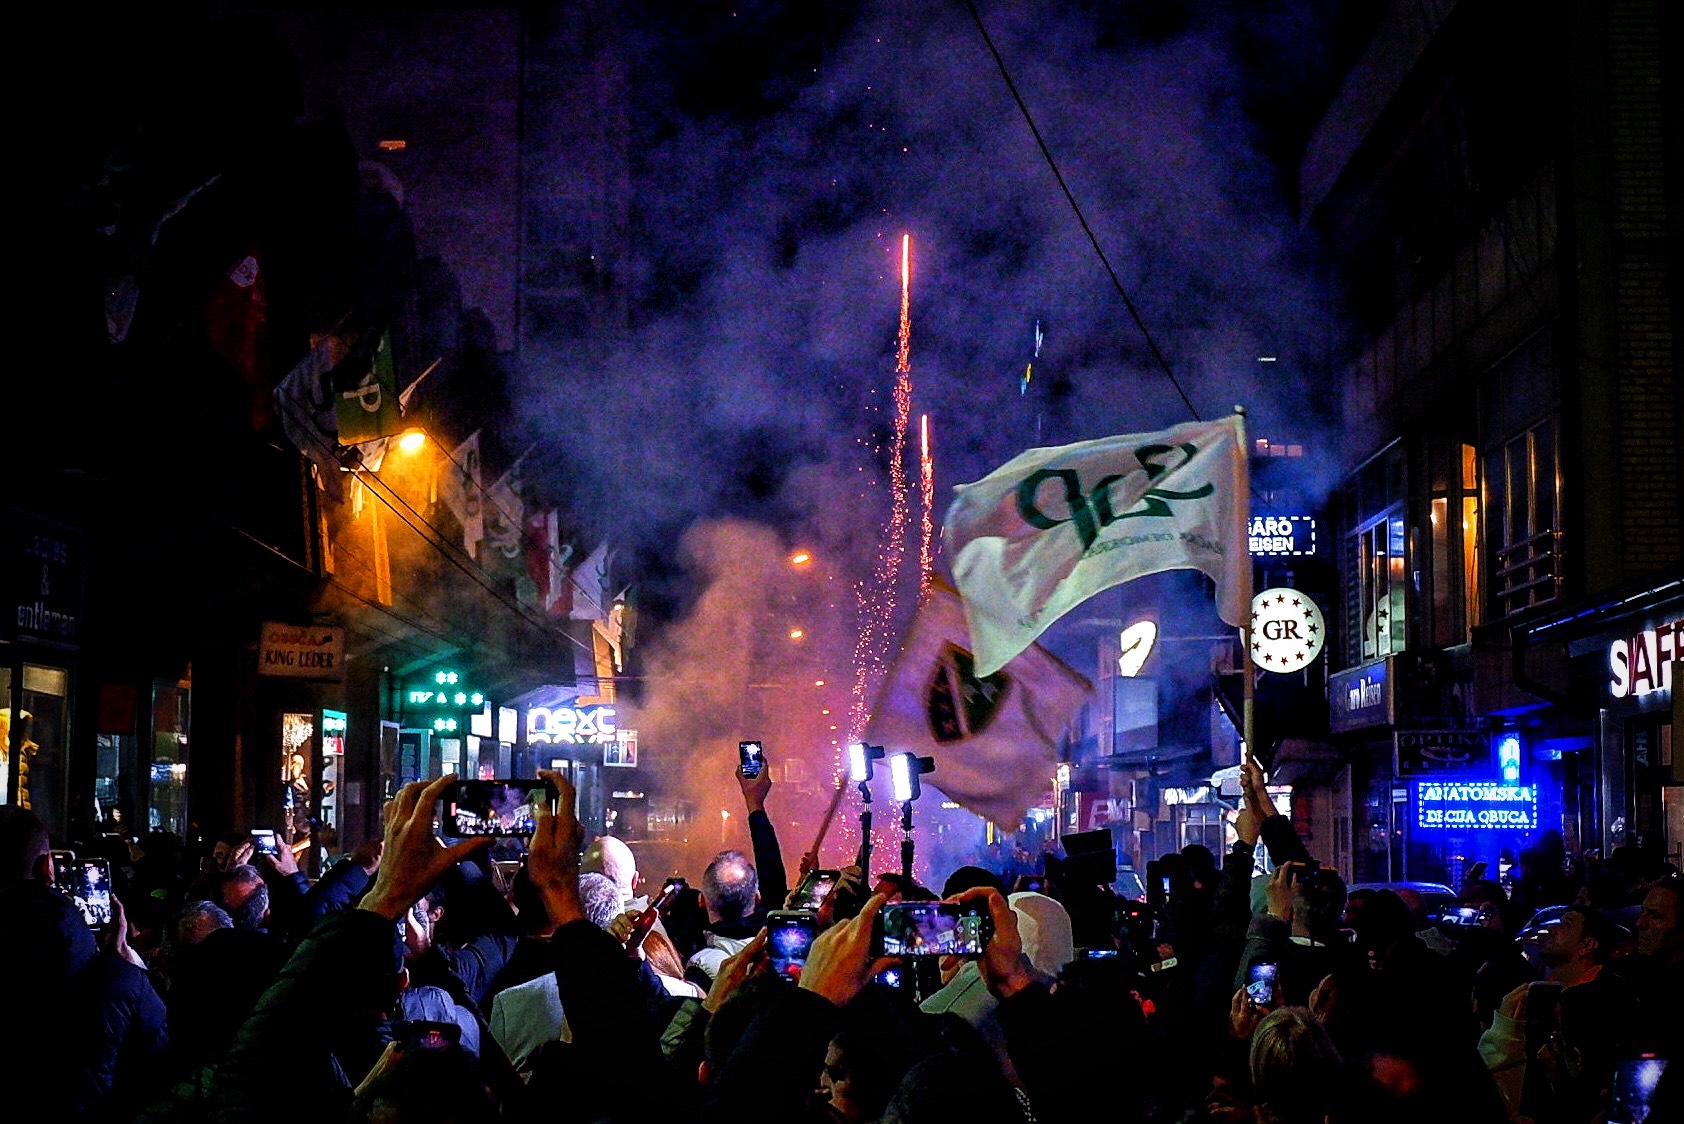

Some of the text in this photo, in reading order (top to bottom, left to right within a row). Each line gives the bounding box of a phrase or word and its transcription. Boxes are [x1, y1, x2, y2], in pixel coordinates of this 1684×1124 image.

[1248, 519, 1293, 537] ARO
[1249, 536, 1294, 552] EISEN
[1262, 620, 1303, 641] GR
[264, 650, 334, 668] KING LEDER
